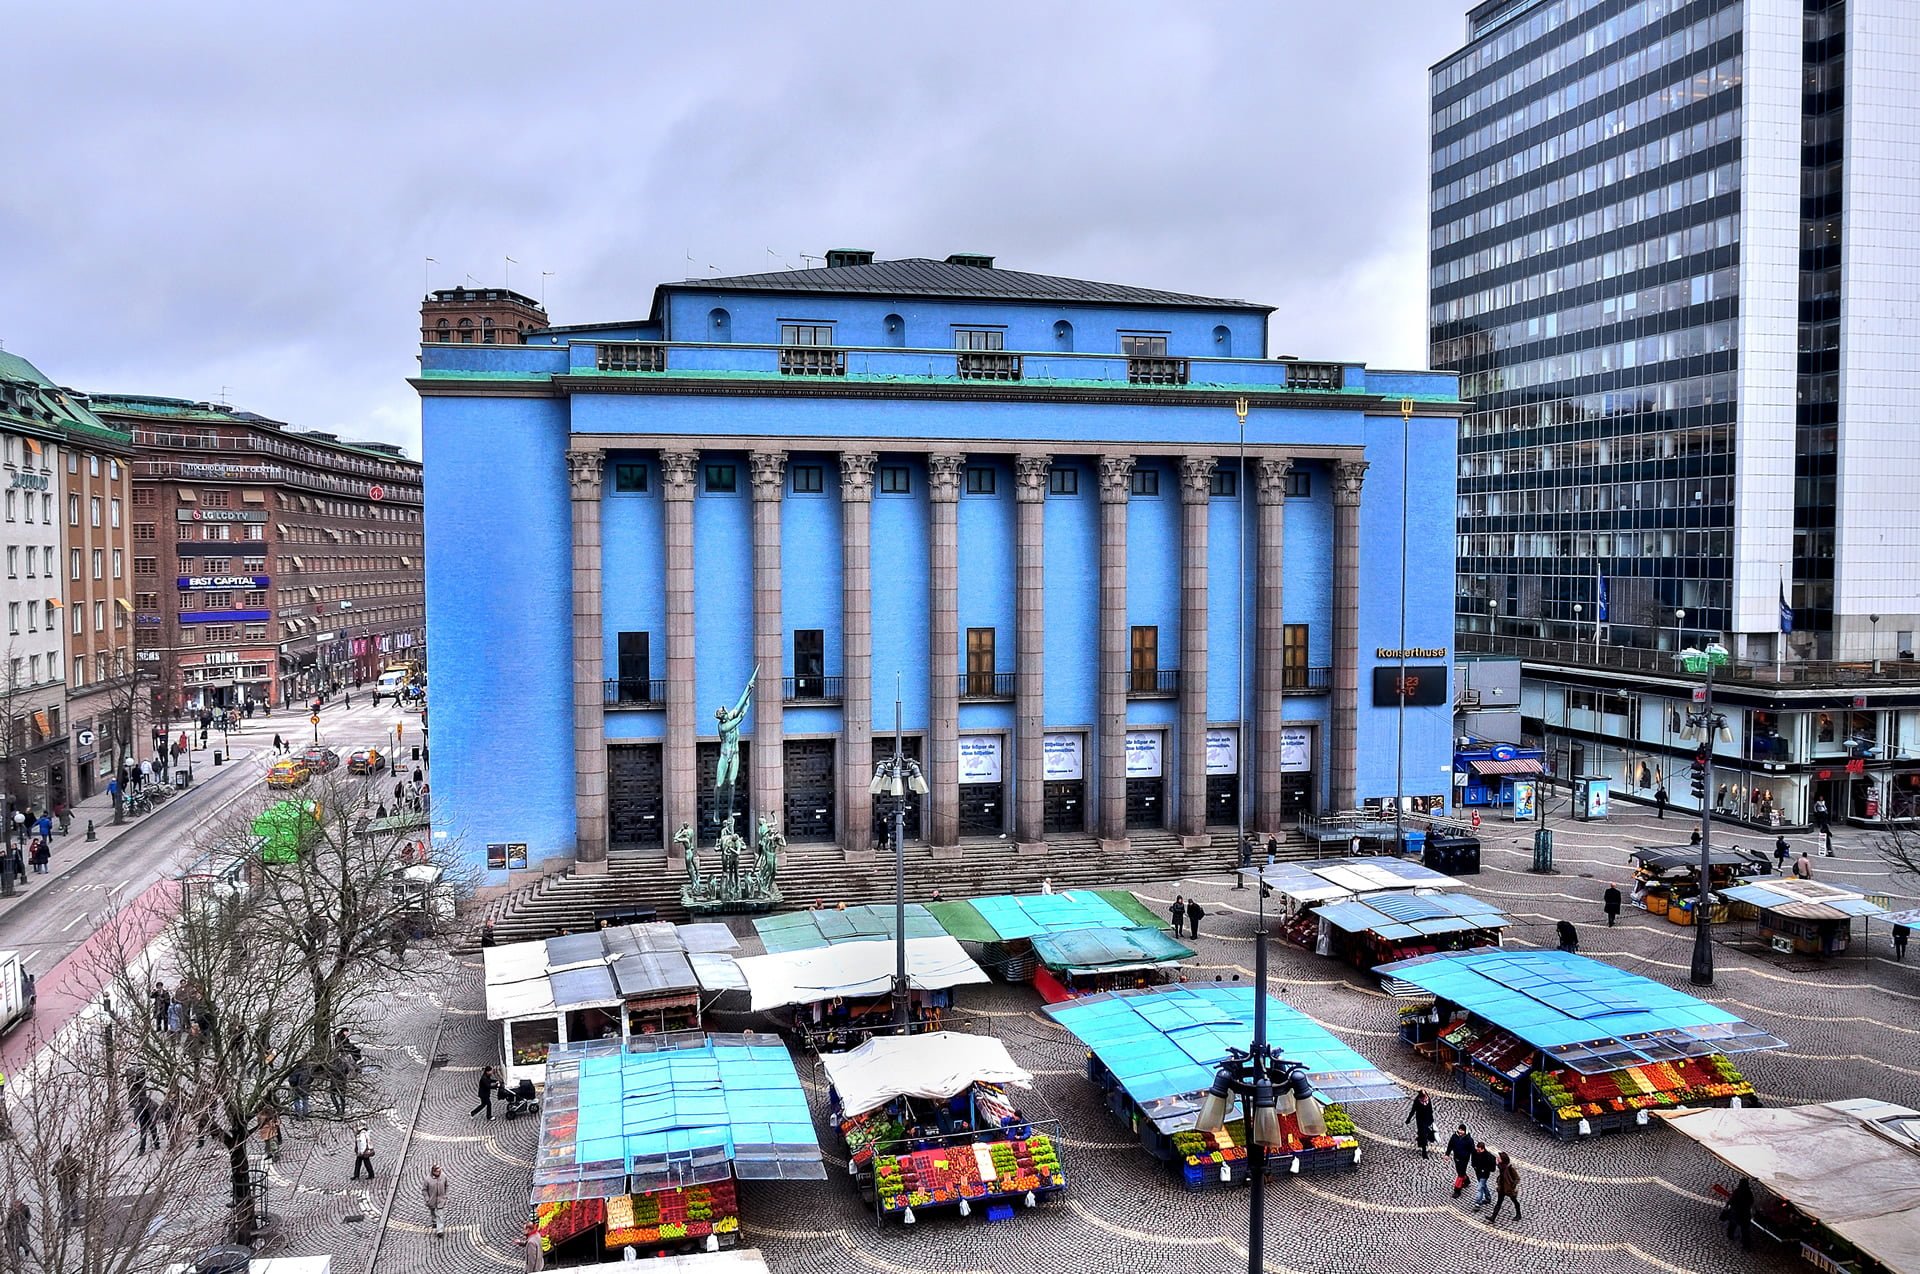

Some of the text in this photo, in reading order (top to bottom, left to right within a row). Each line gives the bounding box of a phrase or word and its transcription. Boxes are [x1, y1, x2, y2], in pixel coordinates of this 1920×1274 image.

[203, 511, 248, 520] LG LCD TV
[189, 576, 256, 586] EAST CAPITAL
[205, 650, 239, 664] STRÖMS
[1377, 647, 1447, 658] Konserthuset
